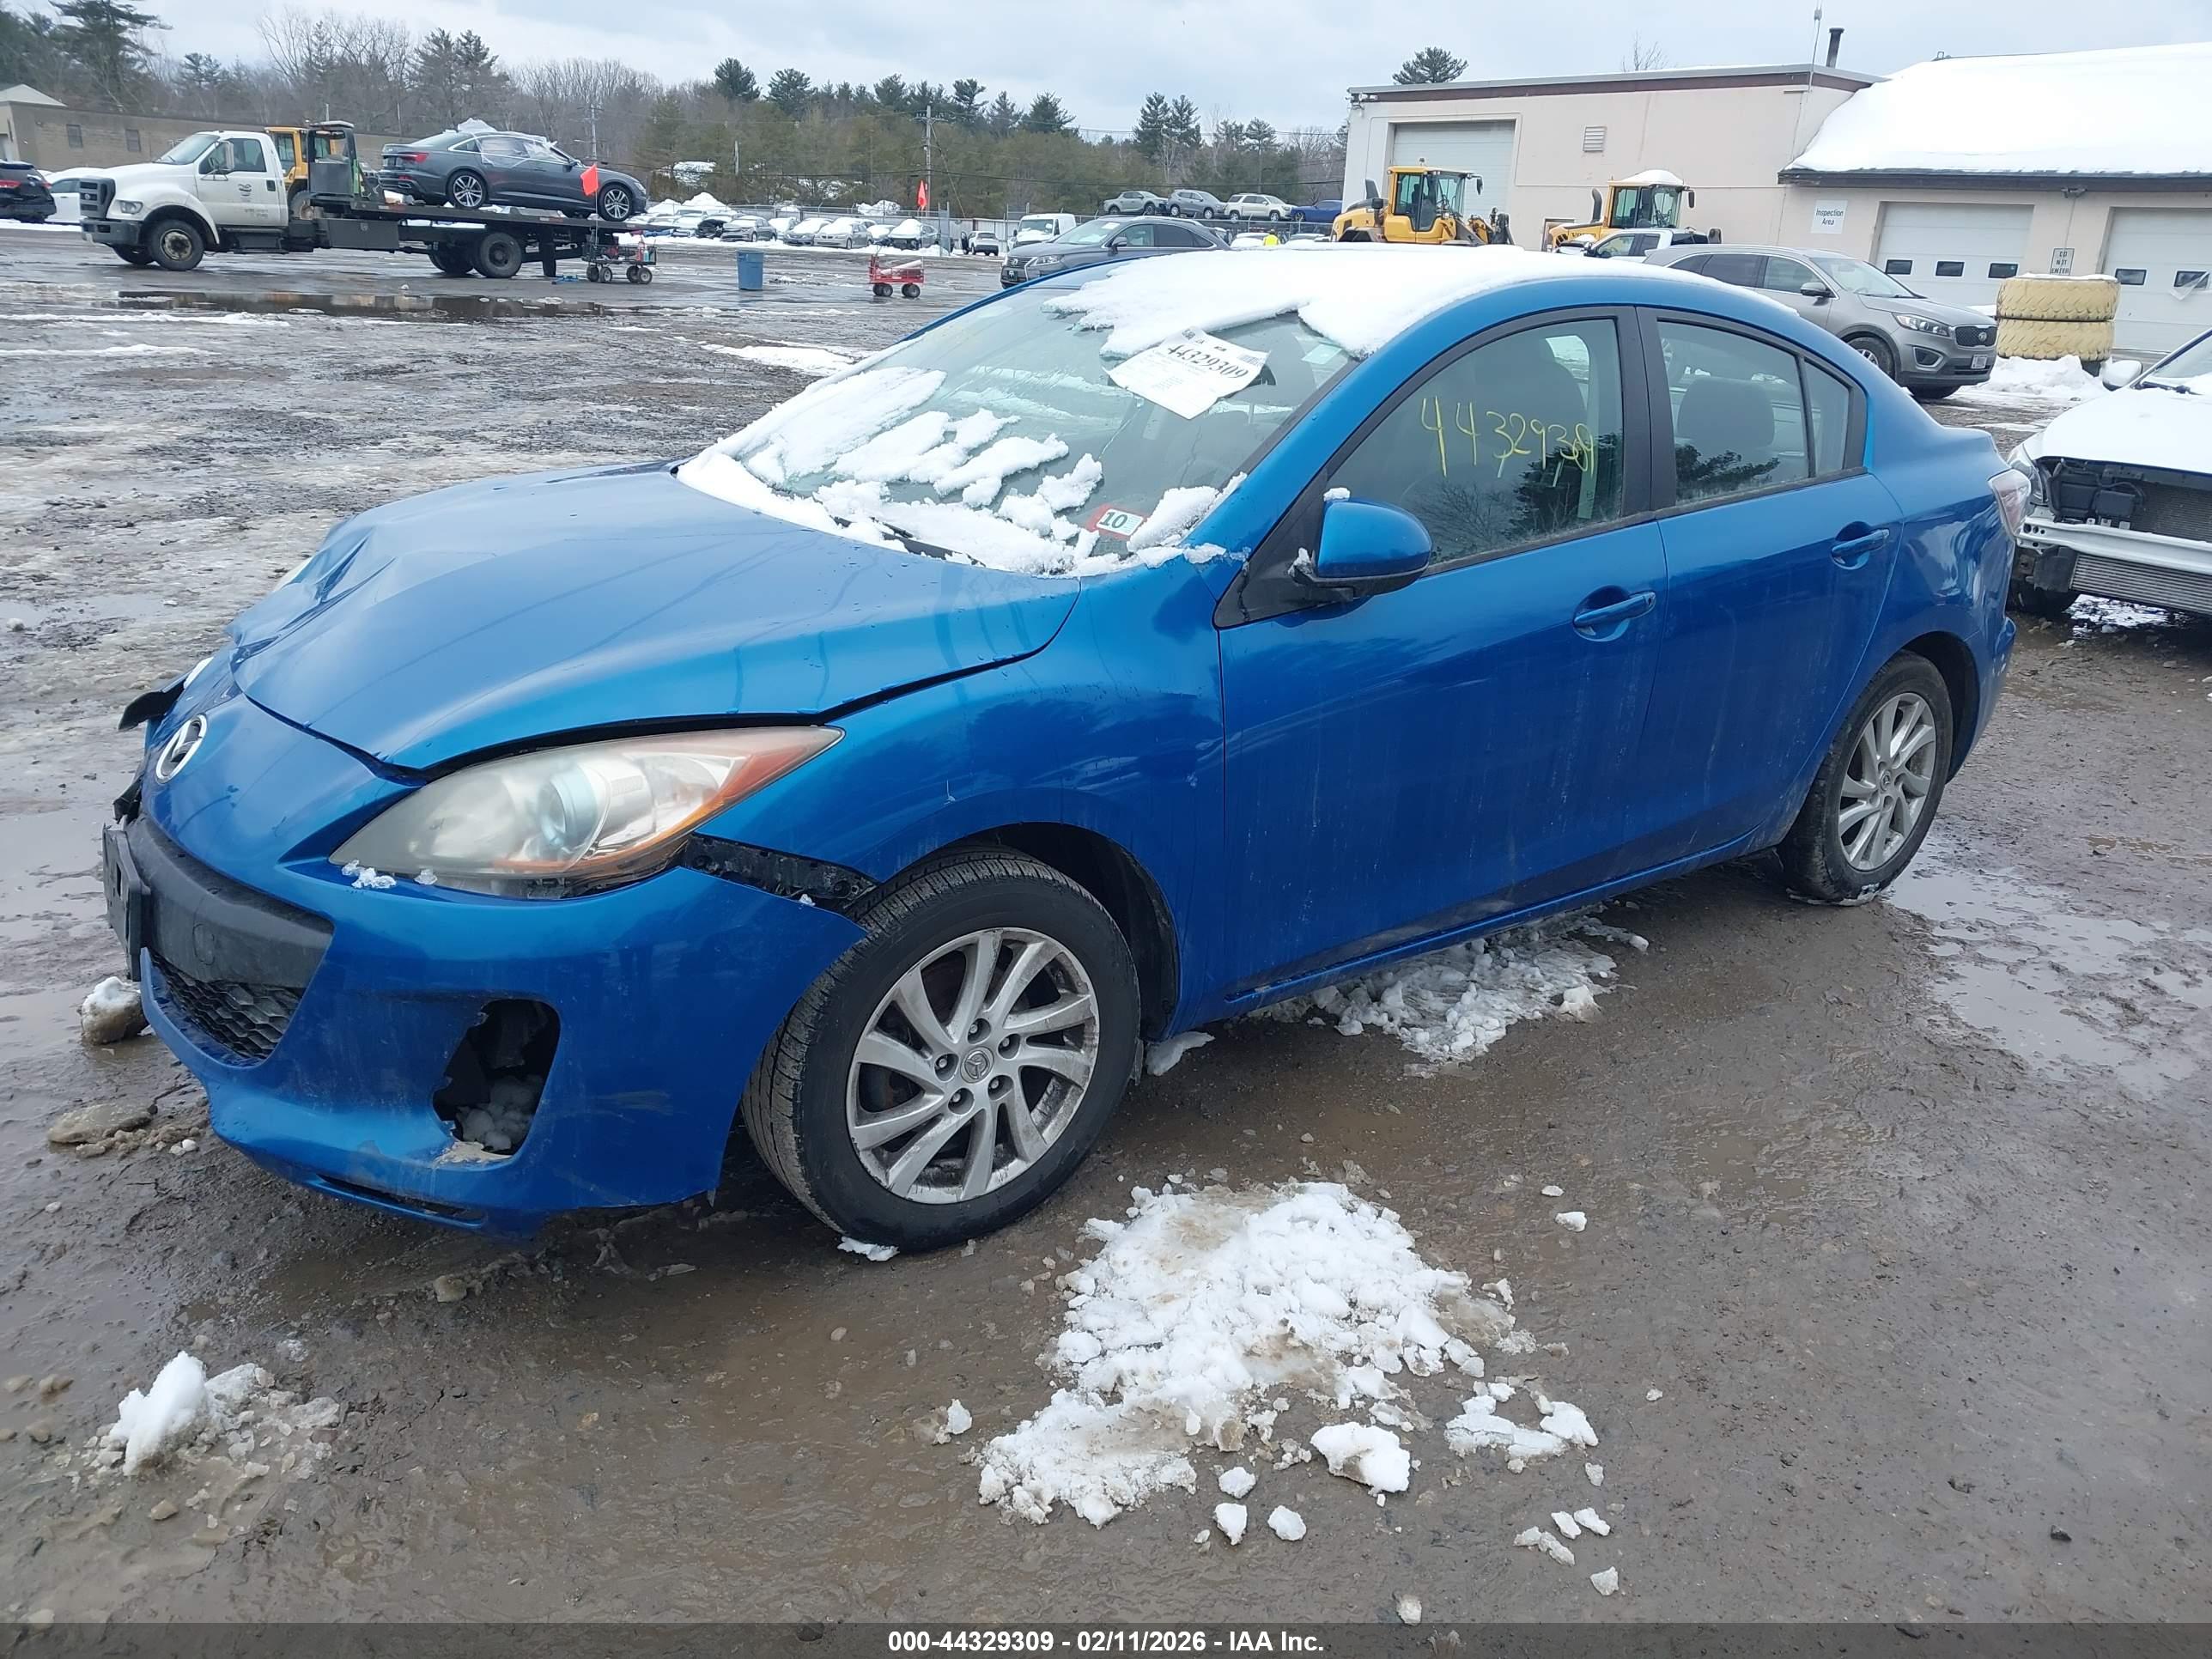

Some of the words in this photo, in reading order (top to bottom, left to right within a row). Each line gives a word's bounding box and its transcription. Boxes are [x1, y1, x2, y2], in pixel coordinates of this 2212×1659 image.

[1816, 208, 1844, 217] Inspection
[1168, 344, 1249, 379] 44329309
[1099, 512, 1128, 529] 10
